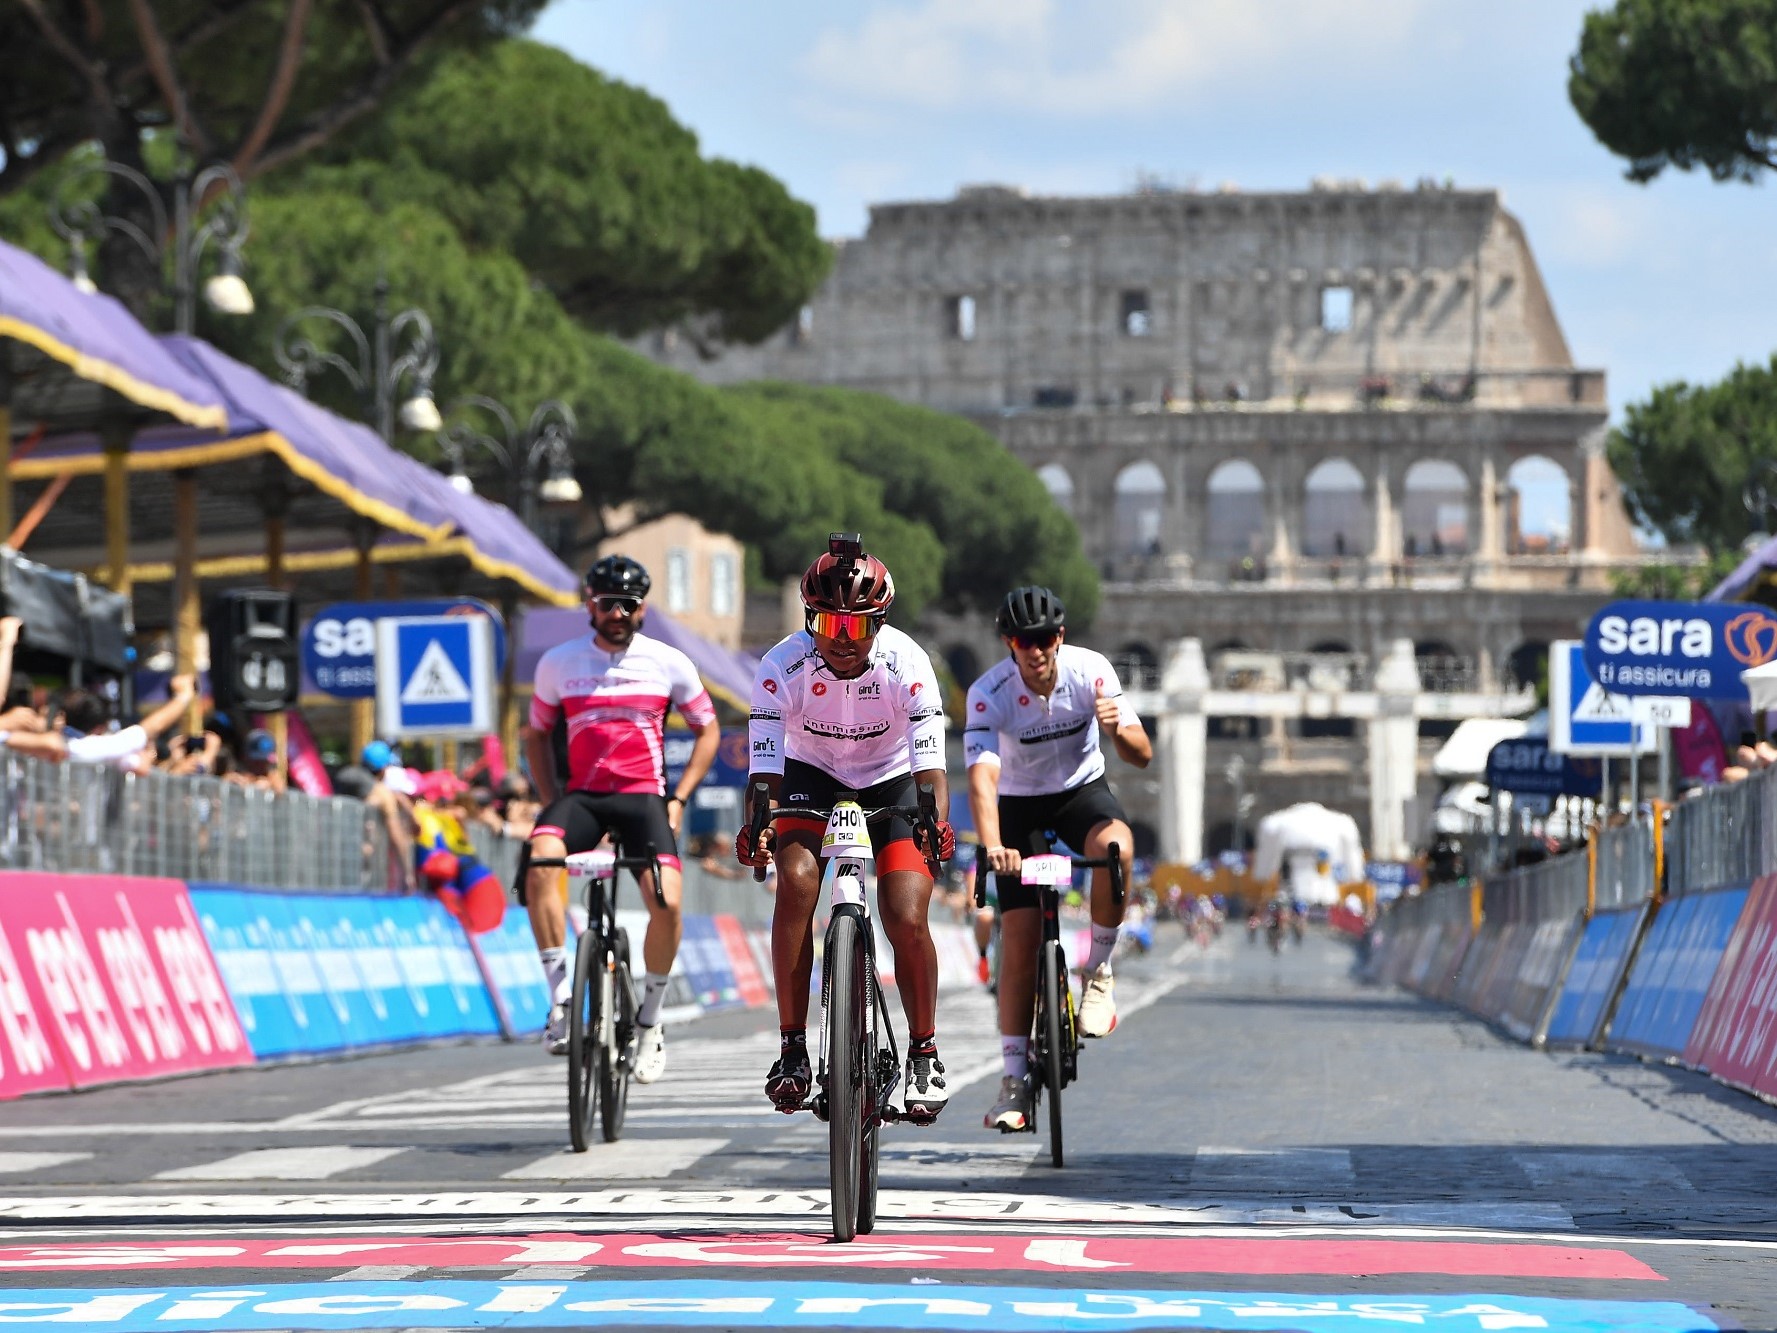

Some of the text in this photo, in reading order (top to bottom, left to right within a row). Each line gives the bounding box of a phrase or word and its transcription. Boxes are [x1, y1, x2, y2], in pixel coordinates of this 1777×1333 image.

[313, 617, 376, 658] sa
[1599, 616, 1712, 658] sara
[1600, 662, 1711, 688] ti assicura
[806, 720, 889, 735] intimissimi
